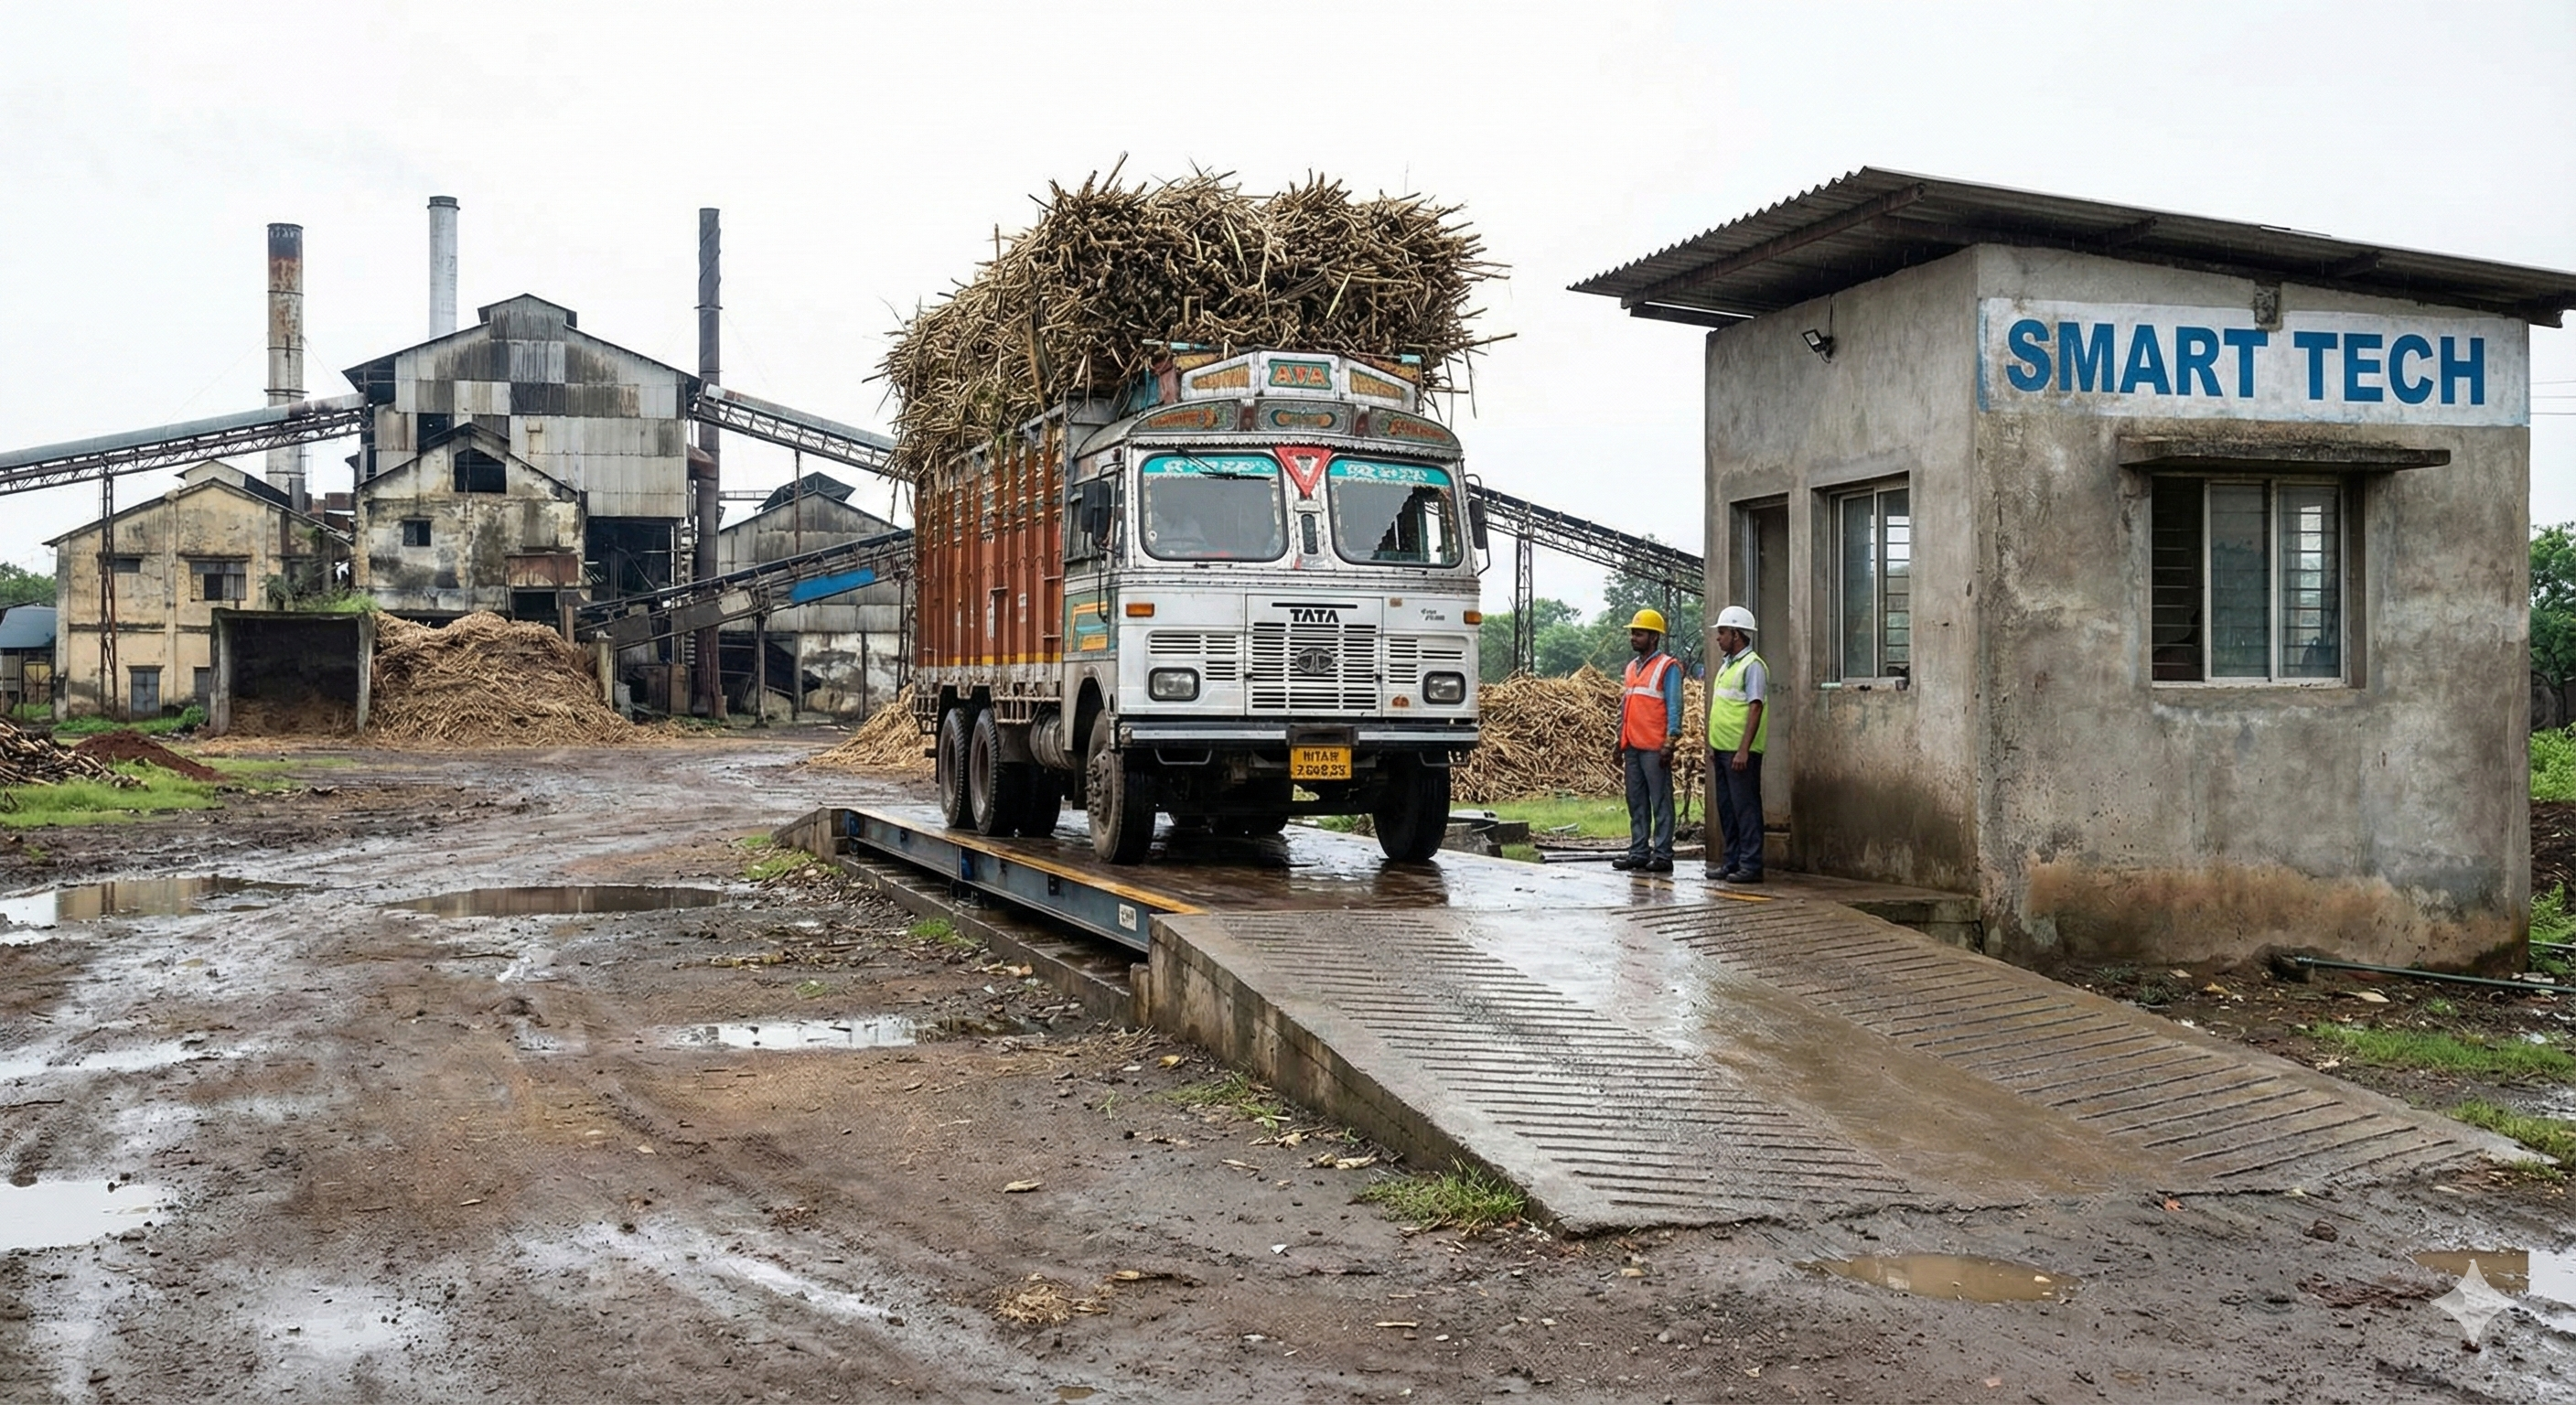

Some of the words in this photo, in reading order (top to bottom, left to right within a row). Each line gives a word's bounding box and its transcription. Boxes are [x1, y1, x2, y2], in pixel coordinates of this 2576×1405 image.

[2006, 319, 2269, 398] SMART
[2293, 331, 2485, 405] TECH
[1290, 608, 1339, 622] TATA
